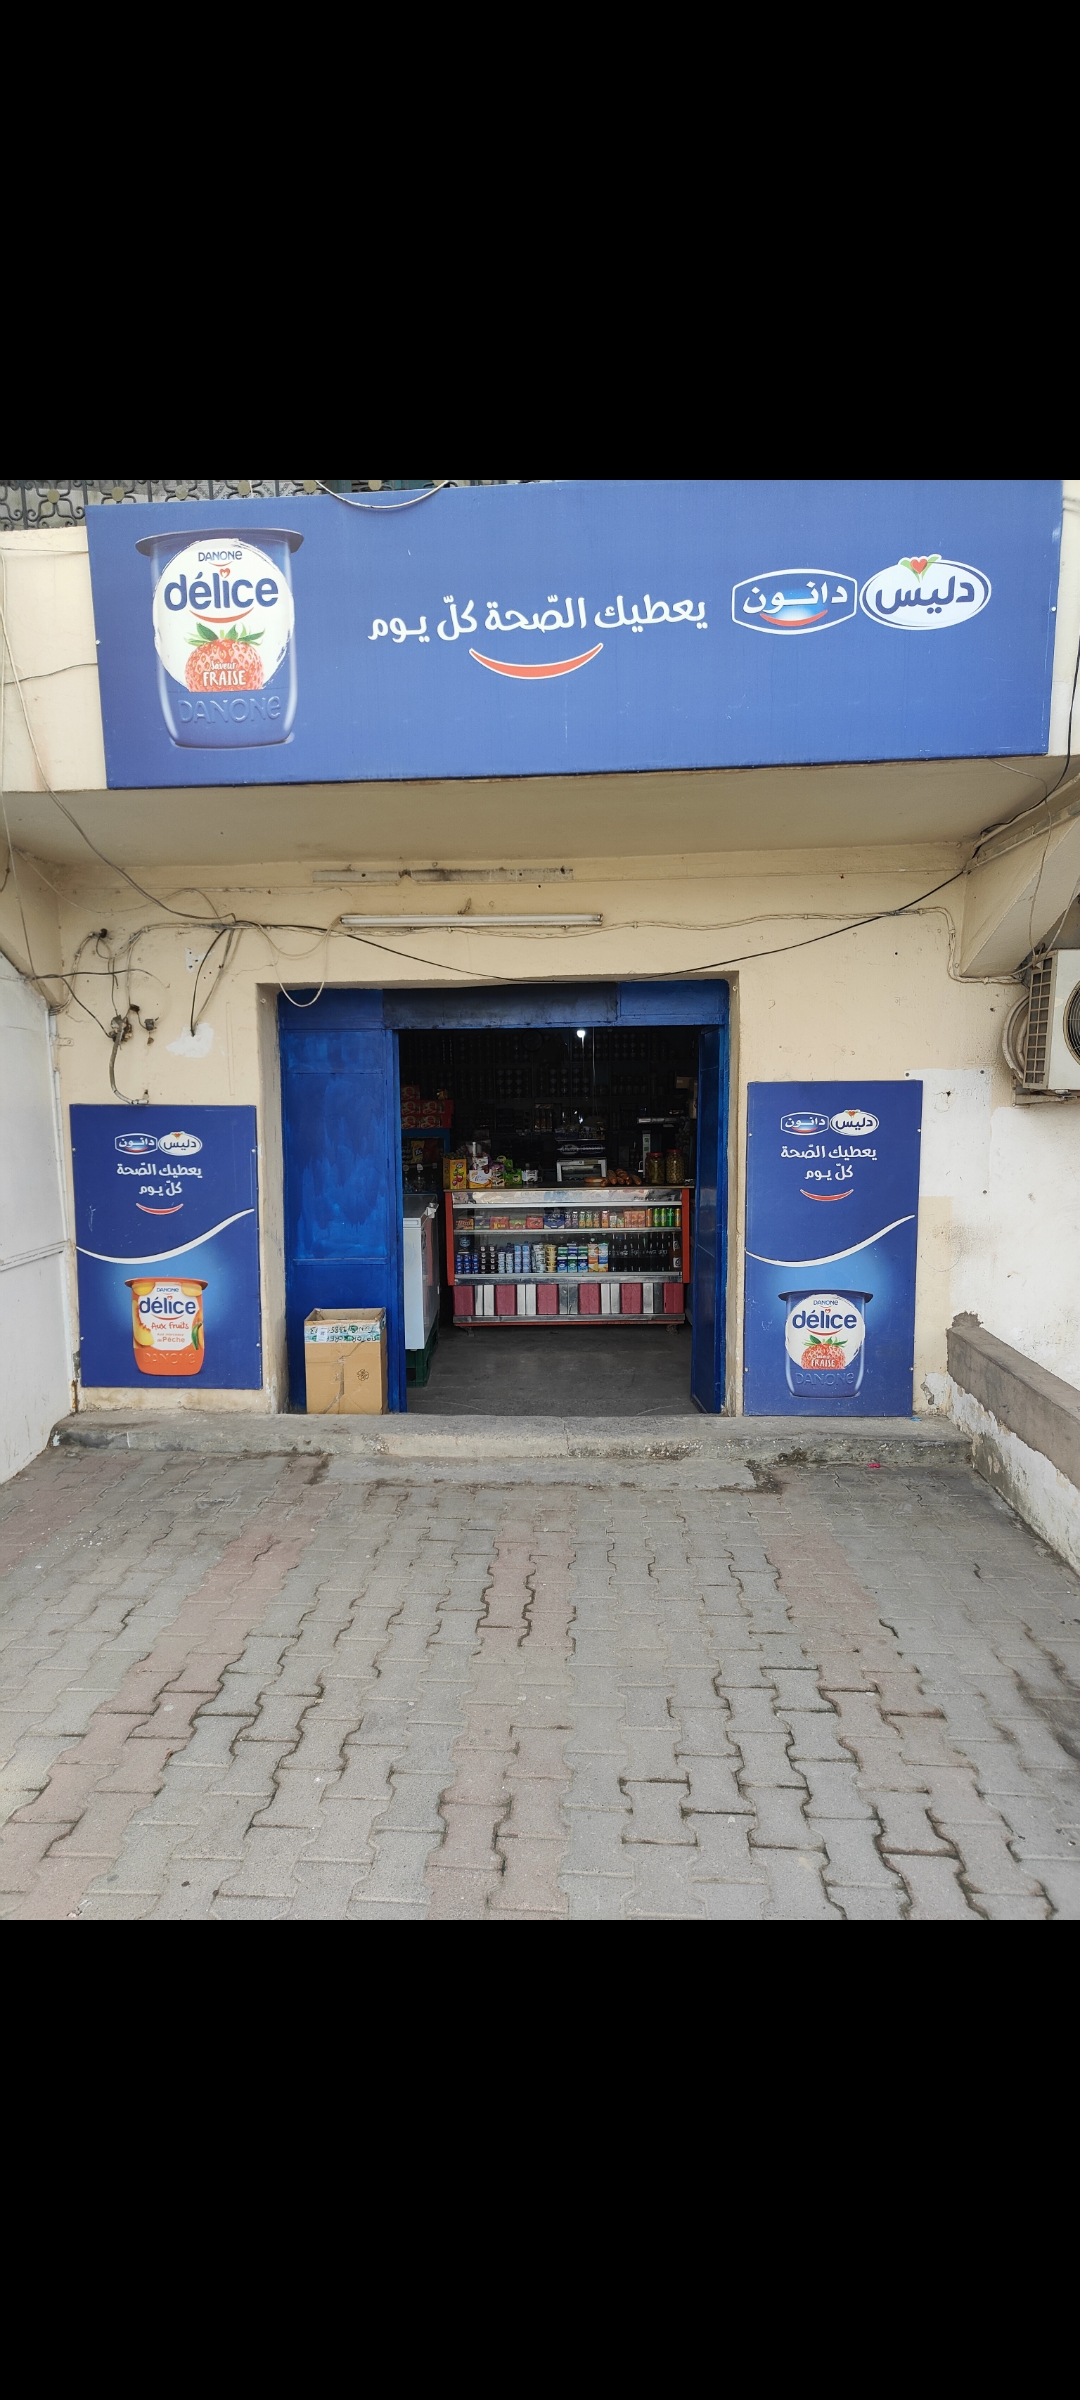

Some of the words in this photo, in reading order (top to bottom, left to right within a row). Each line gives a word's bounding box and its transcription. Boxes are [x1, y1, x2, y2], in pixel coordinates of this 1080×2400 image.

[197, 551, 242, 562] DANONE
[164, 571, 279, 611] délice
[742, 580, 847, 613] دانون
[875, 575, 975, 614] دليس
[593, 594, 708, 633] يعطيك
[202, 669, 246, 687] FRAISE
[178, 695, 281, 724] DANONE
[784, 1117, 826, 1128] دانون
[835, 1117, 873, 1130] دليس
[118, 1137, 155, 1148] دانون
[163, 1139, 197, 1150] دليس
[828, 1146, 877, 1161] يعطيك
[158, 1164, 203, 1178] يعطيك
[139, 1297, 196, 1314] délice
[151, 1322, 166, 1330] Aux
[792, 1310, 857, 1329] délice
[811, 1359, 836, 1367] FRAISE
